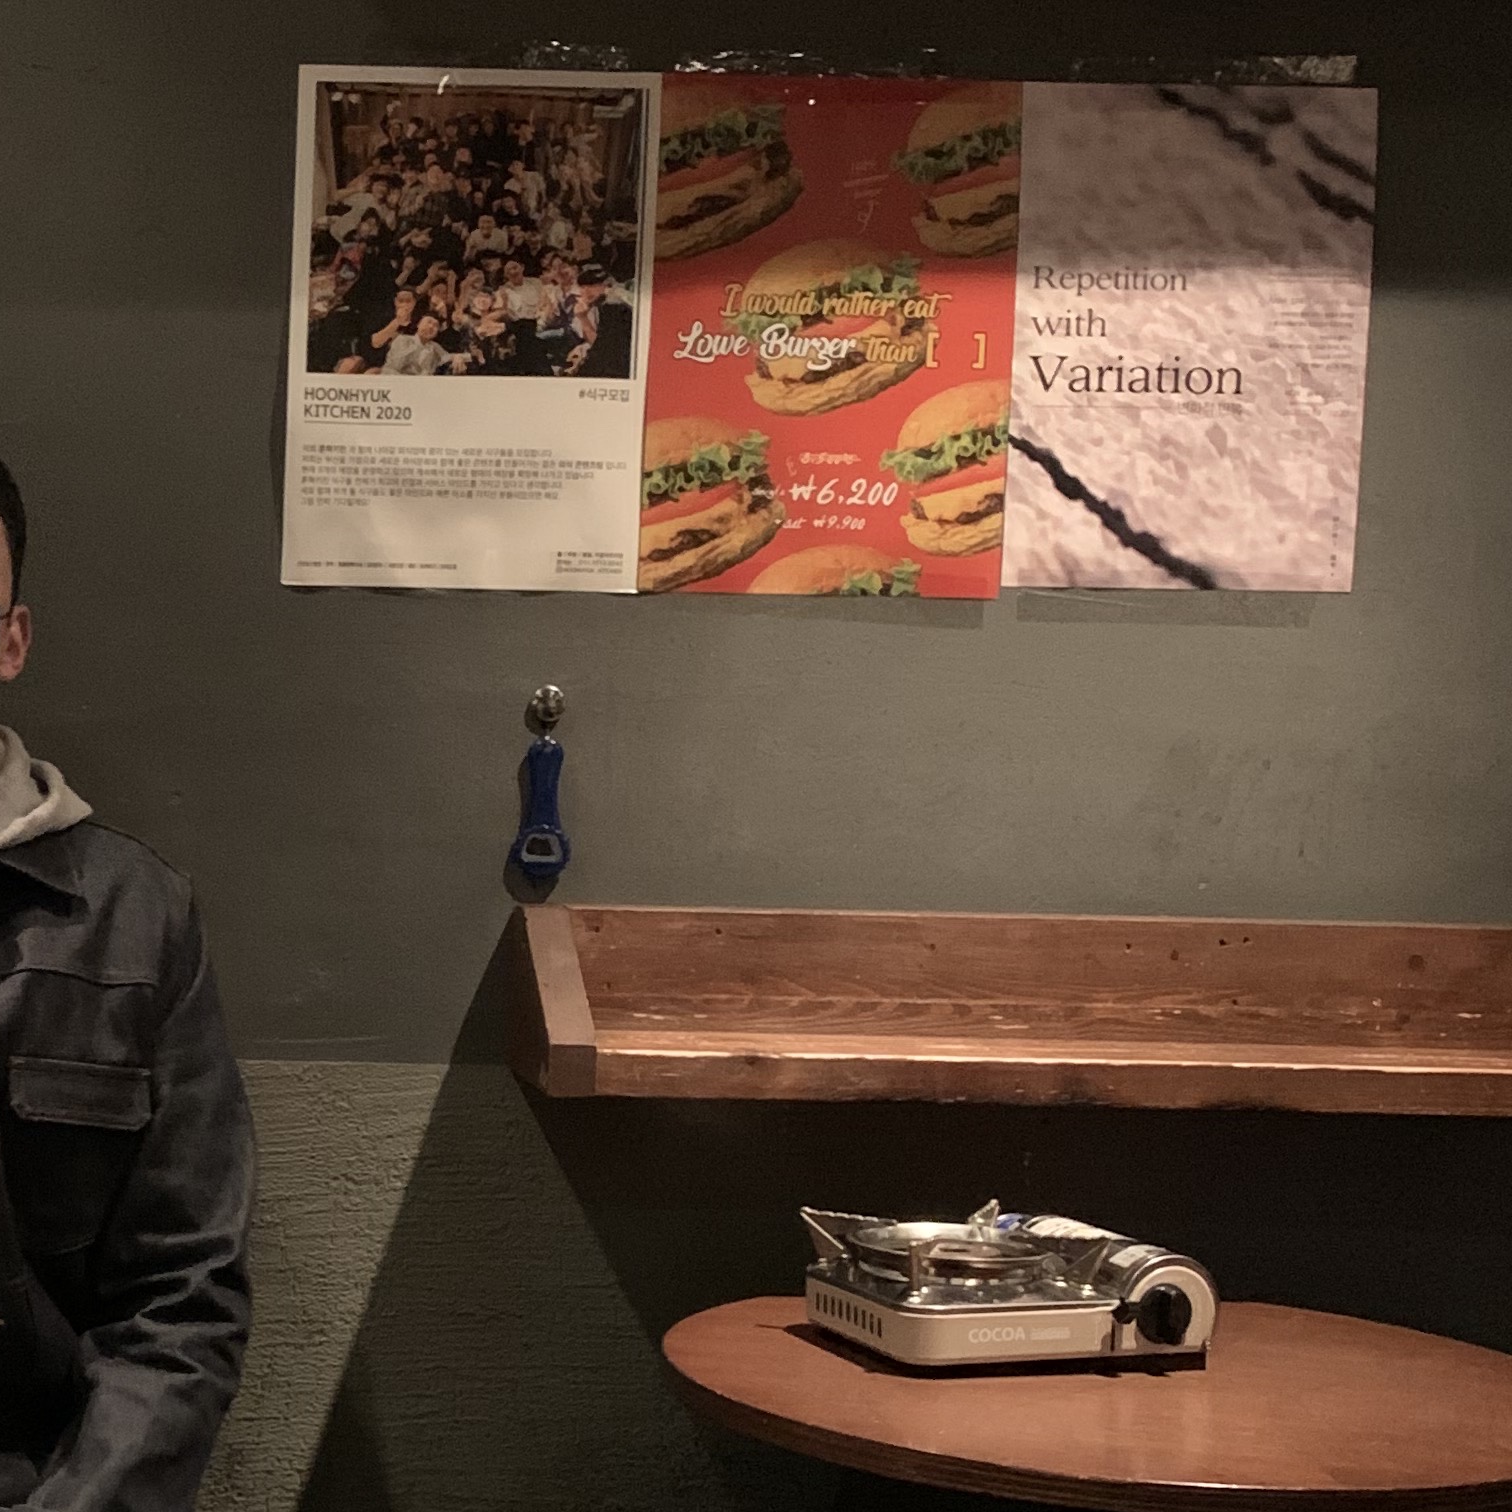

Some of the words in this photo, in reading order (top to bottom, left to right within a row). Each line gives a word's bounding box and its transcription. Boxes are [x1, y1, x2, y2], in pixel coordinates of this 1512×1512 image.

[1033, 265, 1188, 296] Repetition
[744, 290, 819, 317] would
[822, 290, 894, 318] rather
[901, 292, 953, 318] eat
[1031, 308, 1107, 337] with
[759, 323, 856, 371] Burger
[861, 337, 917, 362] than
[1029, 355, 1243, 395] Variation
[304, 387, 391, 402] HOONHYUK
[304, 404, 371, 419] KITCHEN
[376, 405, 412, 420] 2020
[968, 1326, 1026, 1344] COCOA
